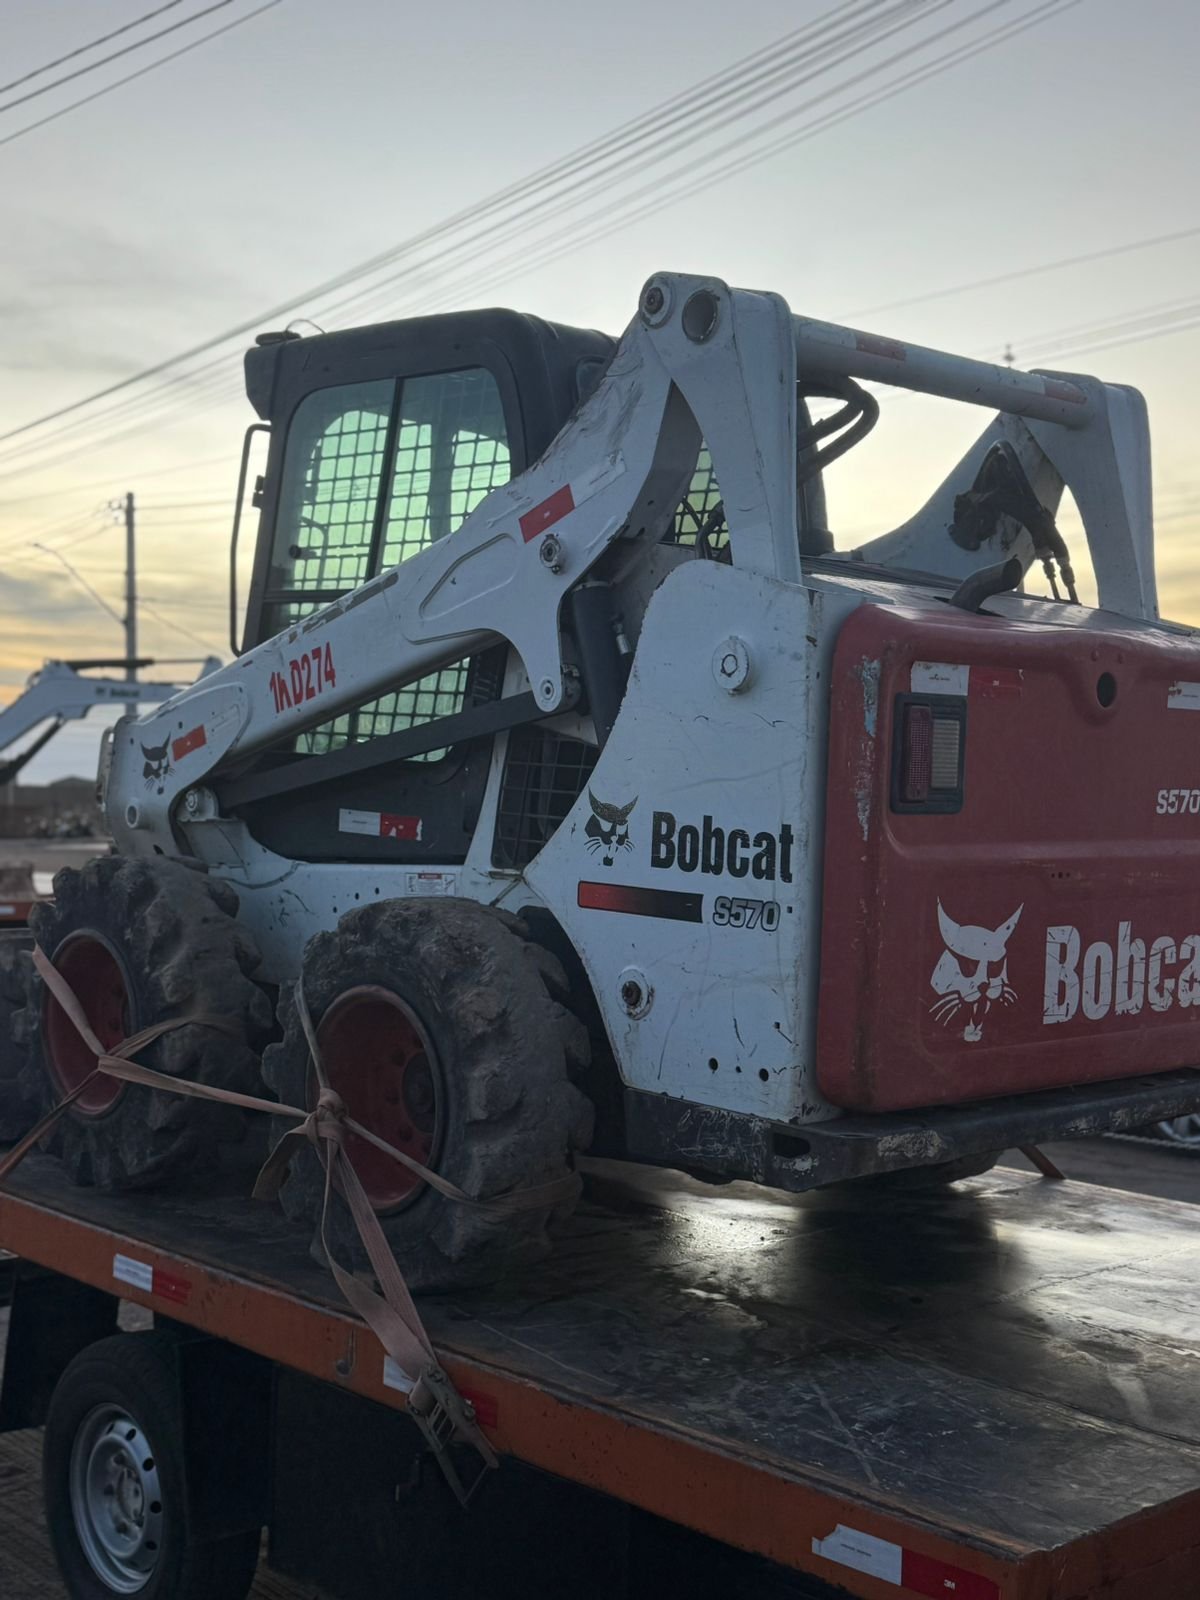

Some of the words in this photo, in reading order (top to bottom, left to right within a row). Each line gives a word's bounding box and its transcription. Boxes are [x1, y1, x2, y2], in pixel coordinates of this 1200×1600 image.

[1155, 788, 1200, 815] S570
[650, 811, 794, 883] Bobcat
[712, 895, 781, 932] S570
